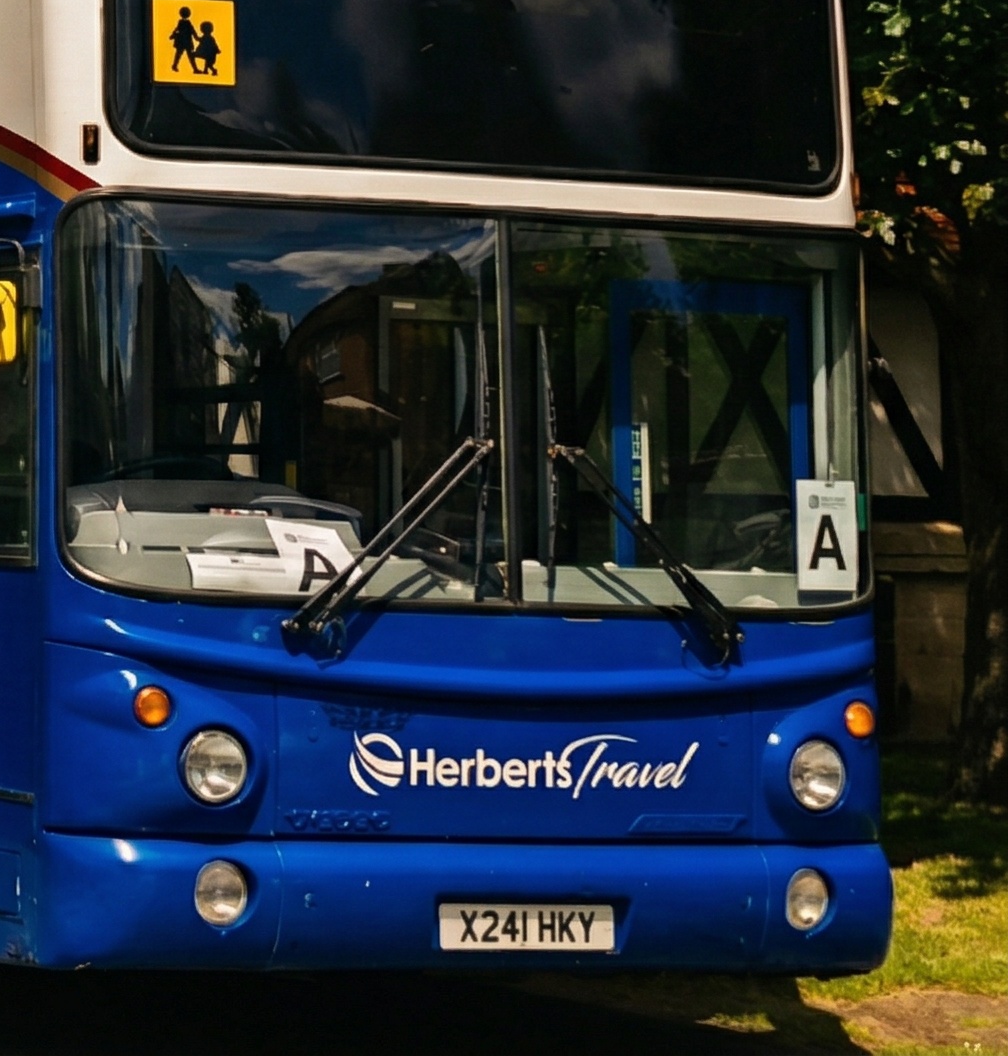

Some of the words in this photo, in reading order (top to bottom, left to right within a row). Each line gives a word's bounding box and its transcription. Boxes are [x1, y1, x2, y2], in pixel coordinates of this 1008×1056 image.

[809, 514, 847, 571] A
[298, 548, 339, 592] A
[410, 747, 572, 789] Herberts
[561, 734, 699, 799] Travel
[460, 910, 527, 943] X241
[539, 911, 595, 943] HKY
